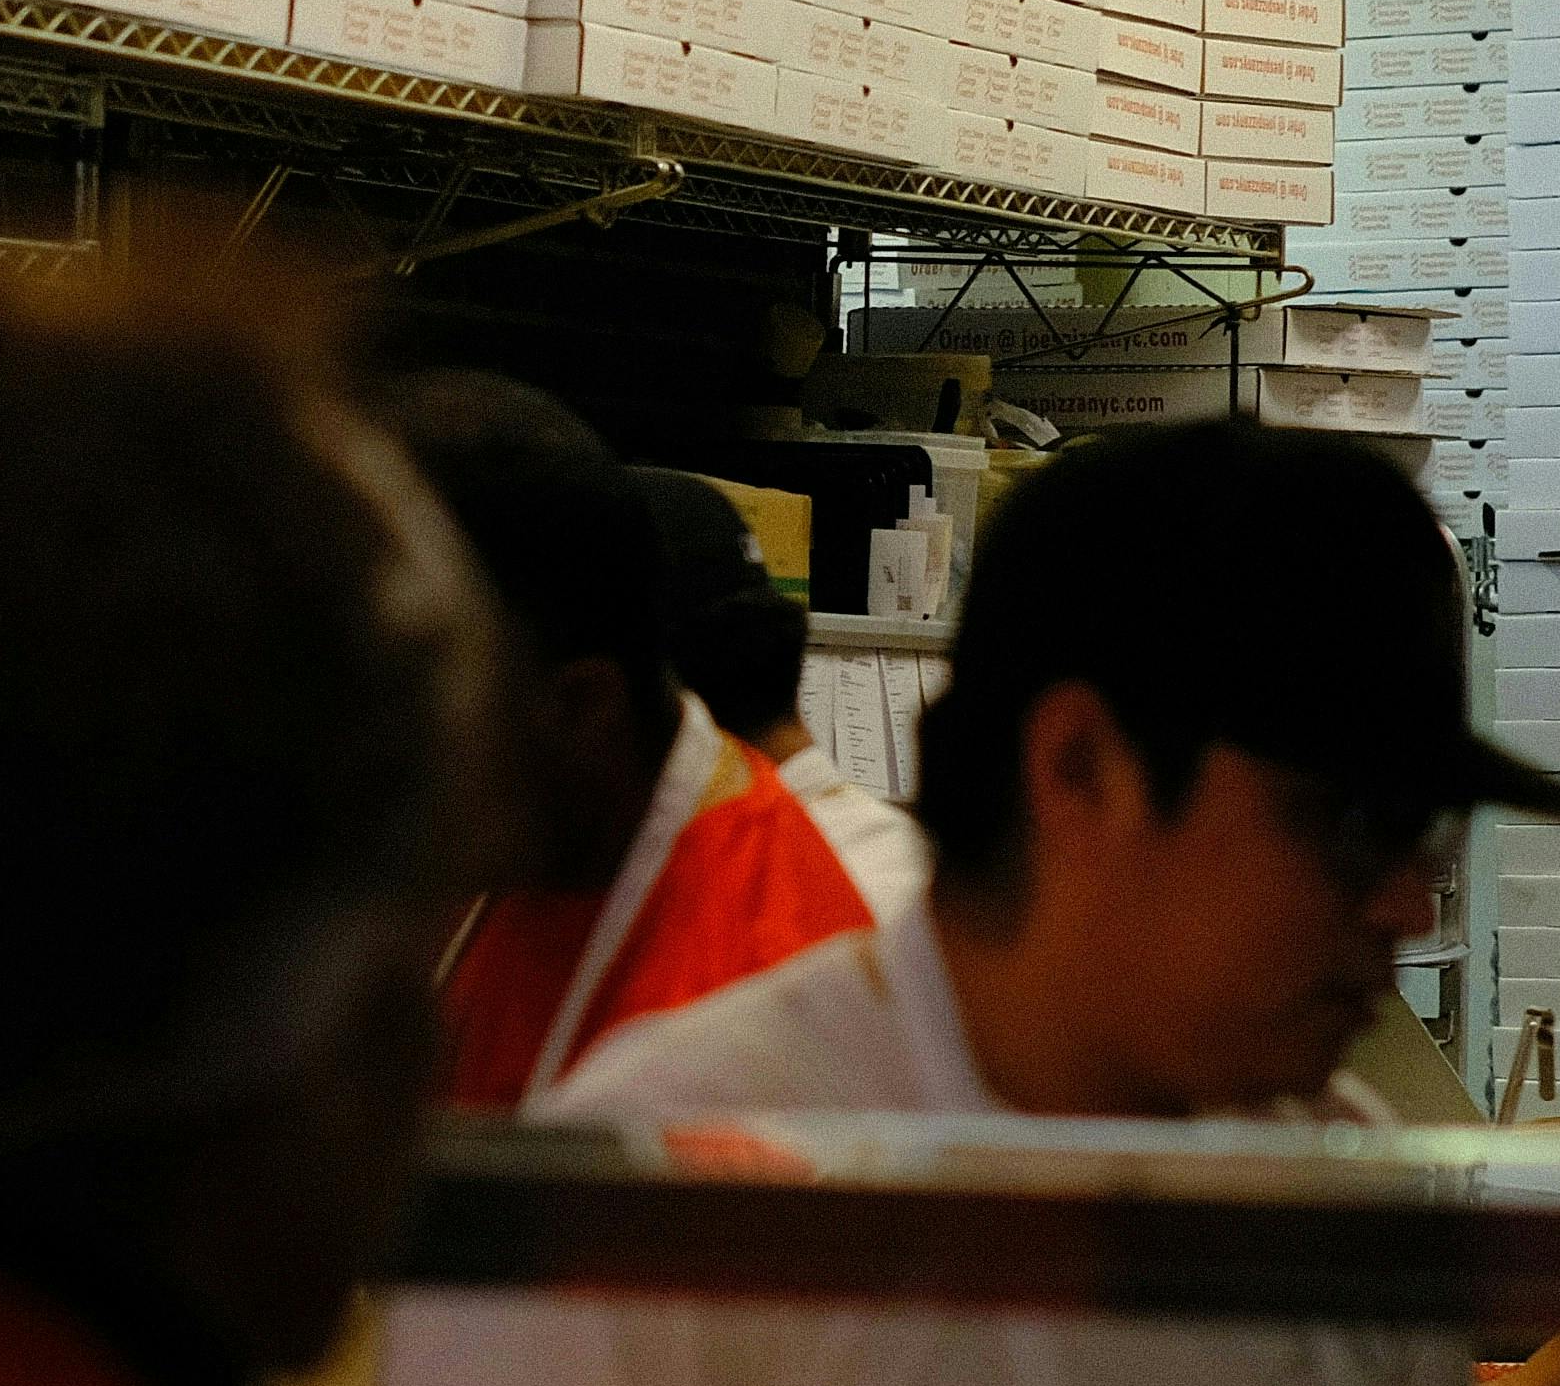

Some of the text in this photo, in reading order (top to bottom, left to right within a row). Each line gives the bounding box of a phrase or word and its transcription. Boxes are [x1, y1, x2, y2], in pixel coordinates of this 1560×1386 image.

[940, 329, 990, 351] Order
[997, 330, 1015, 353] @
[1010, 395, 1164, 417] espizzanyc.com
